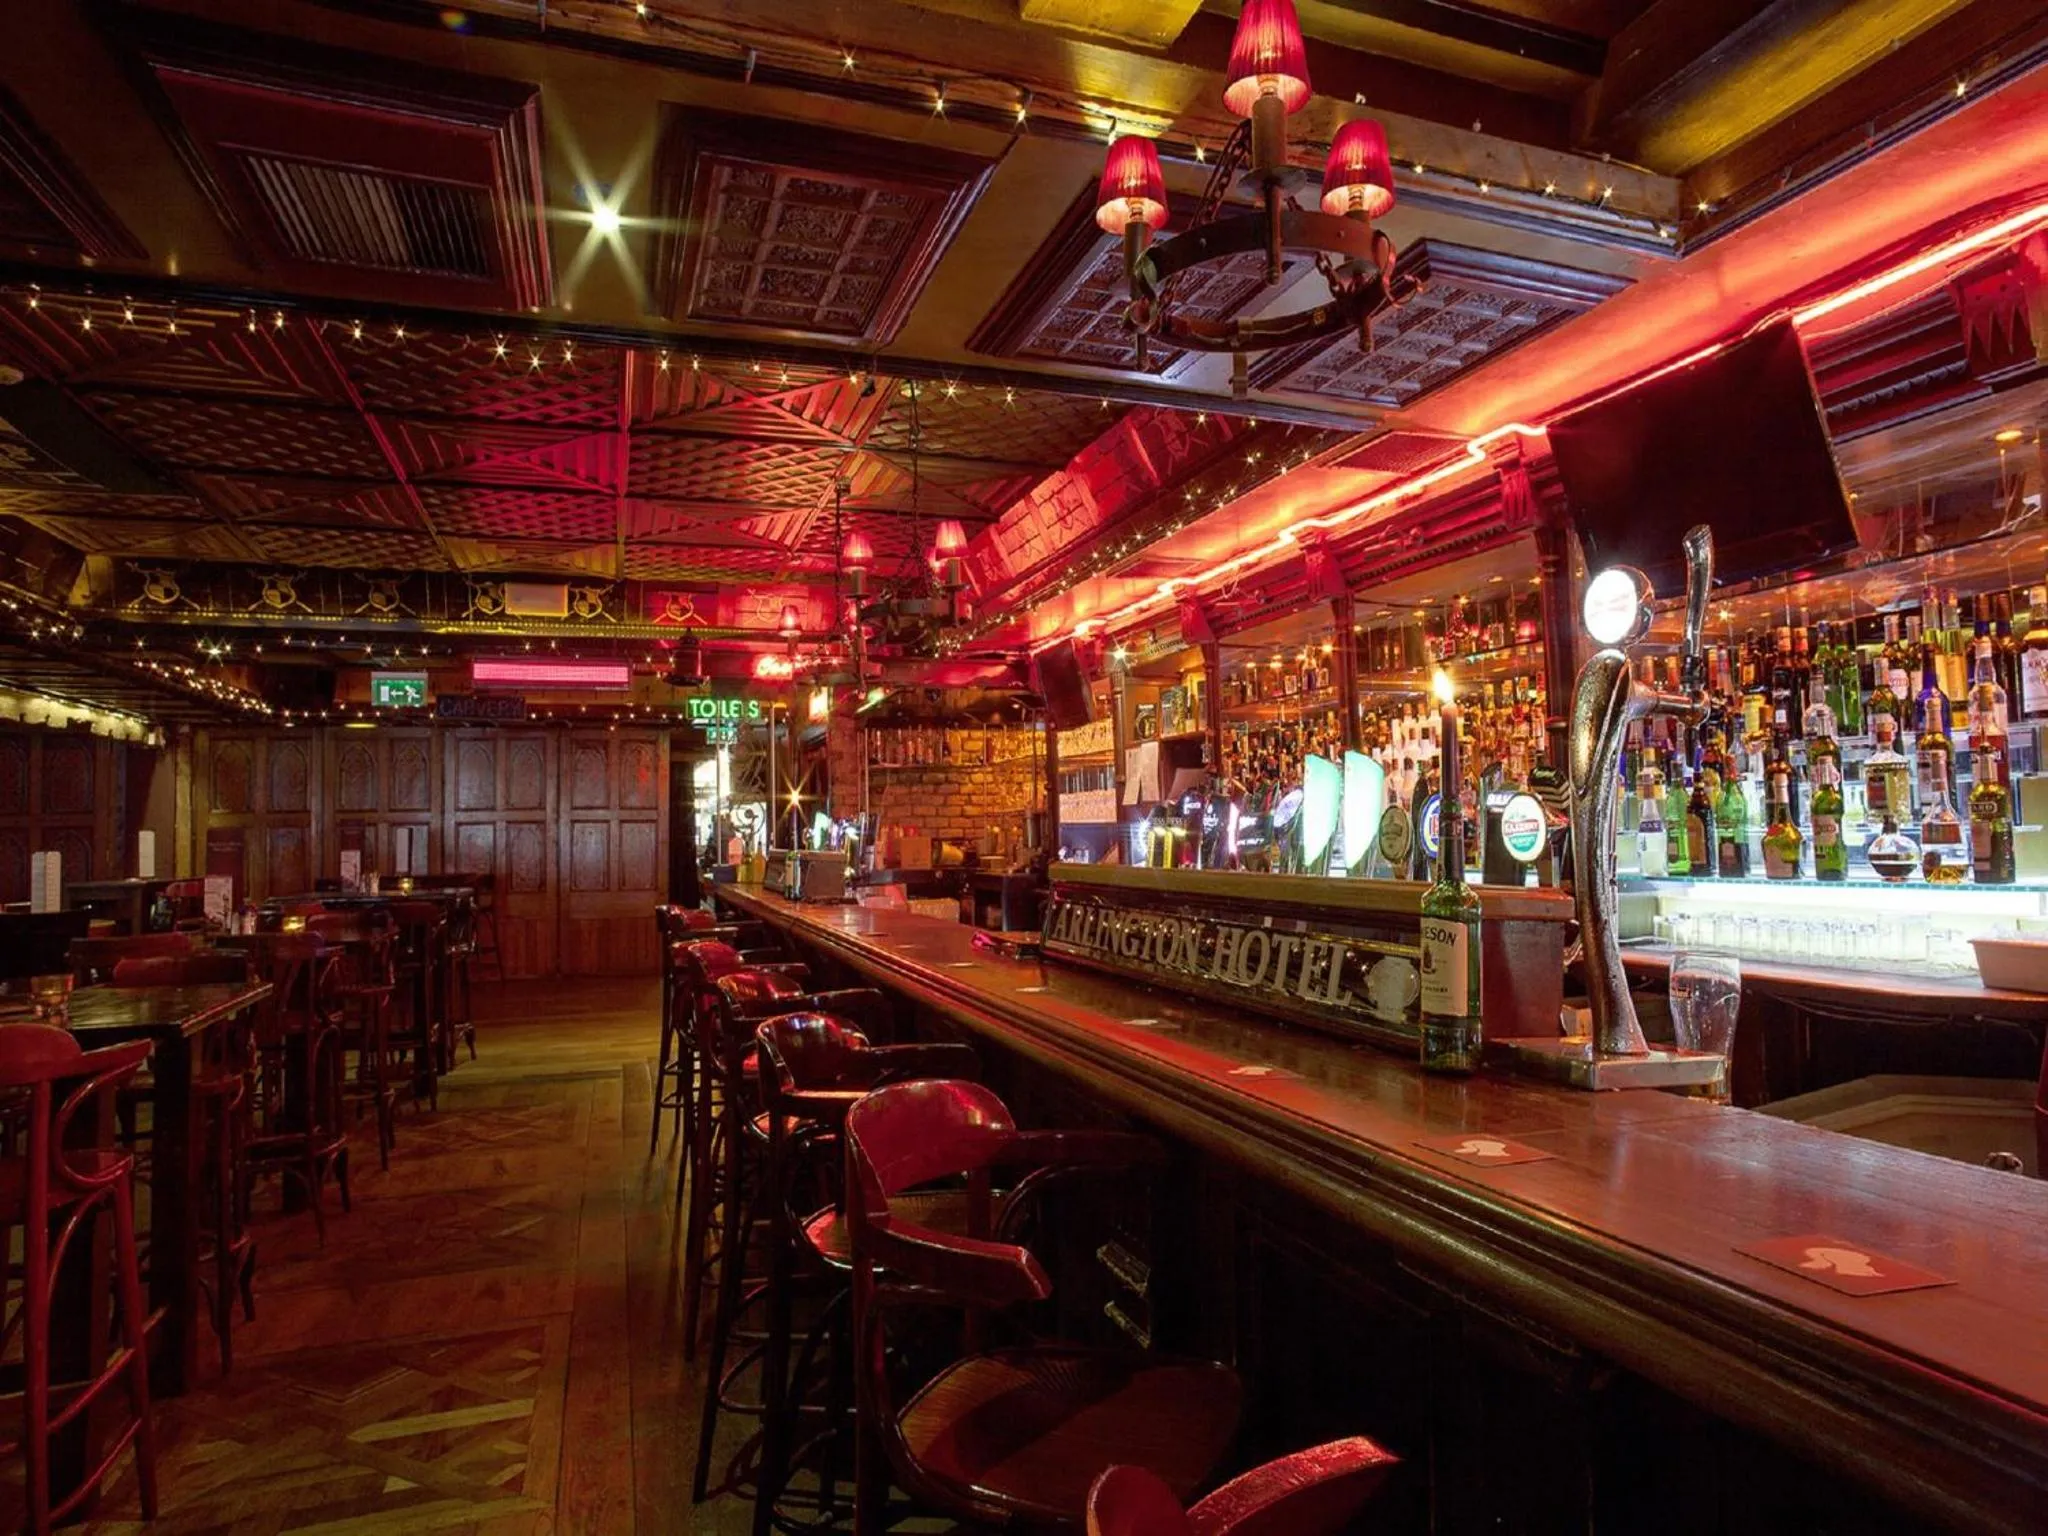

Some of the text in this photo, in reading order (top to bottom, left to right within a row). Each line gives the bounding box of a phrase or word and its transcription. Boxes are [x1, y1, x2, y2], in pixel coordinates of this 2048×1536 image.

[689, 699, 759, 718] TOLES
[1424, 926, 1457, 947] ESON
[1054, 902, 1352, 1006] ARLINGTON HOTEL
